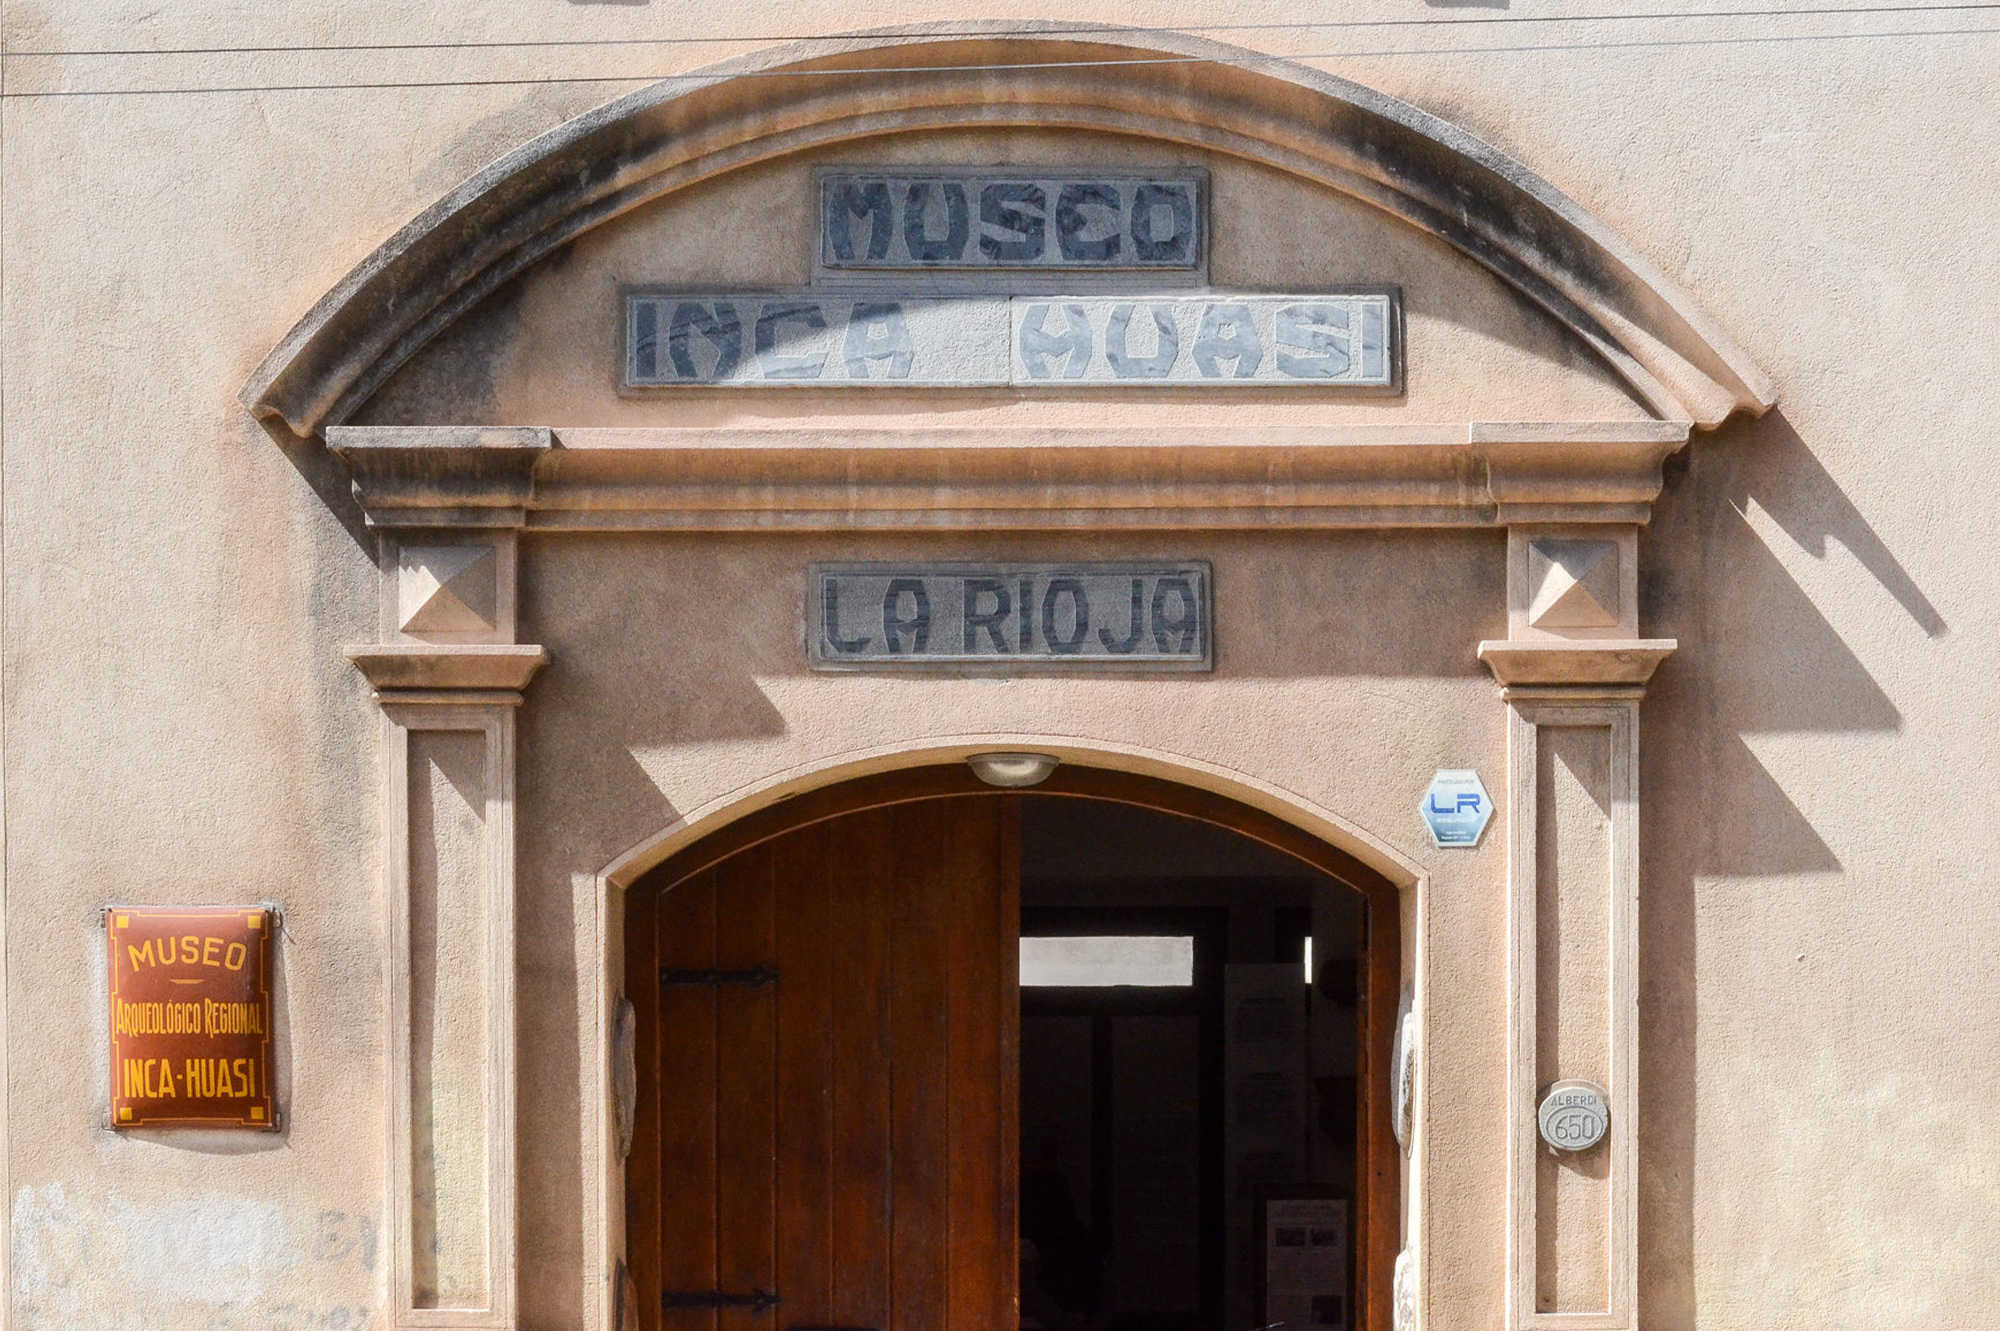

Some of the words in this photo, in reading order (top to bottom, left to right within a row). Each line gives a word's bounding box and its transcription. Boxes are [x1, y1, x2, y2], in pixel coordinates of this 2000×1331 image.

[829, 183, 1192, 260] MUSEO
[636, 302, 914, 378] INCA
[1019, 303, 1383, 378] HUASI
[825, 578, 930, 653] LA
[963, 578, 1197, 654] RIOJA
[1431, 793, 1480, 813] LR
[127, 936, 247, 972] MUSEO
[204, 998, 263, 1038] REGIONAL
[1551, 1095, 1597, 1106] ALBERDI
[1555, 1114, 1595, 1140] 650
